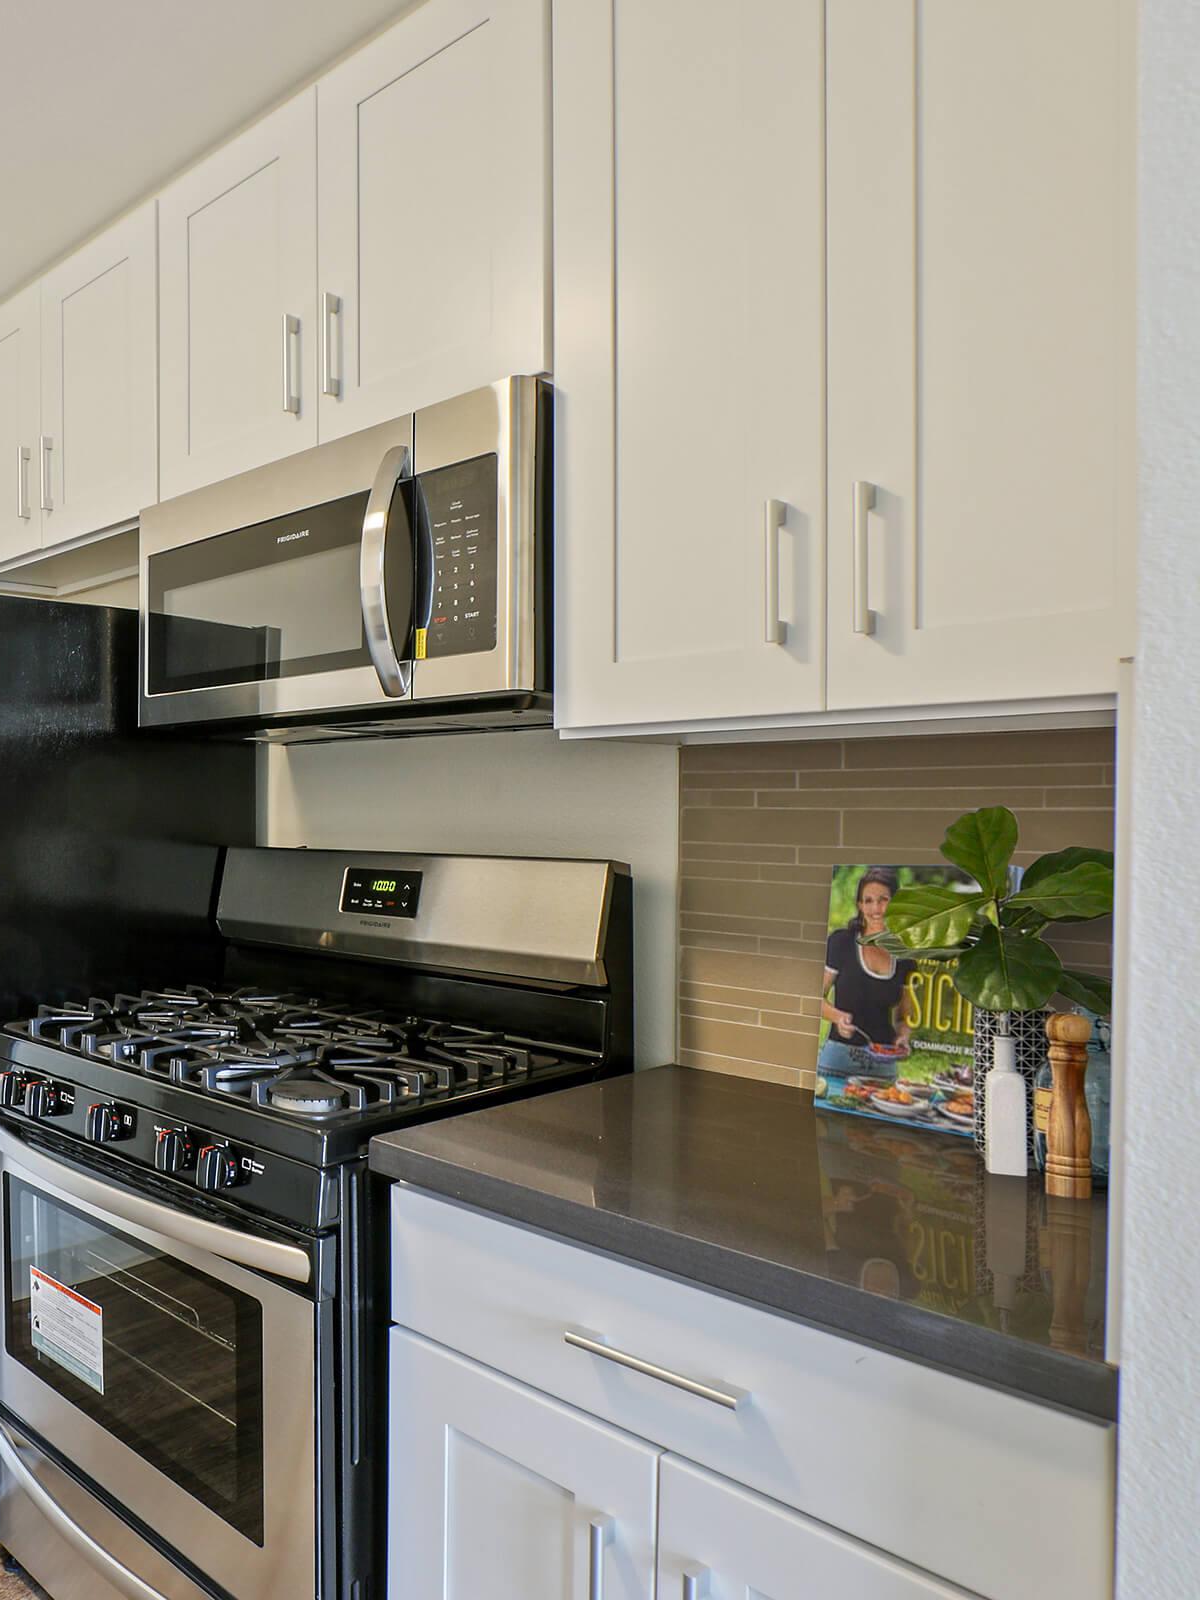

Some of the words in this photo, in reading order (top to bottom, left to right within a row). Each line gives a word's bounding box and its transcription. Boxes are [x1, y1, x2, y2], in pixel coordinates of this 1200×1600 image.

[277, 529, 310, 544] FRIGIDAIRE
[465, 611, 480, 619] START
[360, 919, 391, 928] FRIGIDAIRE
[907, 972, 975, 1034] SICIL
[913, 1040, 962, 1054] DOMINIQUE
